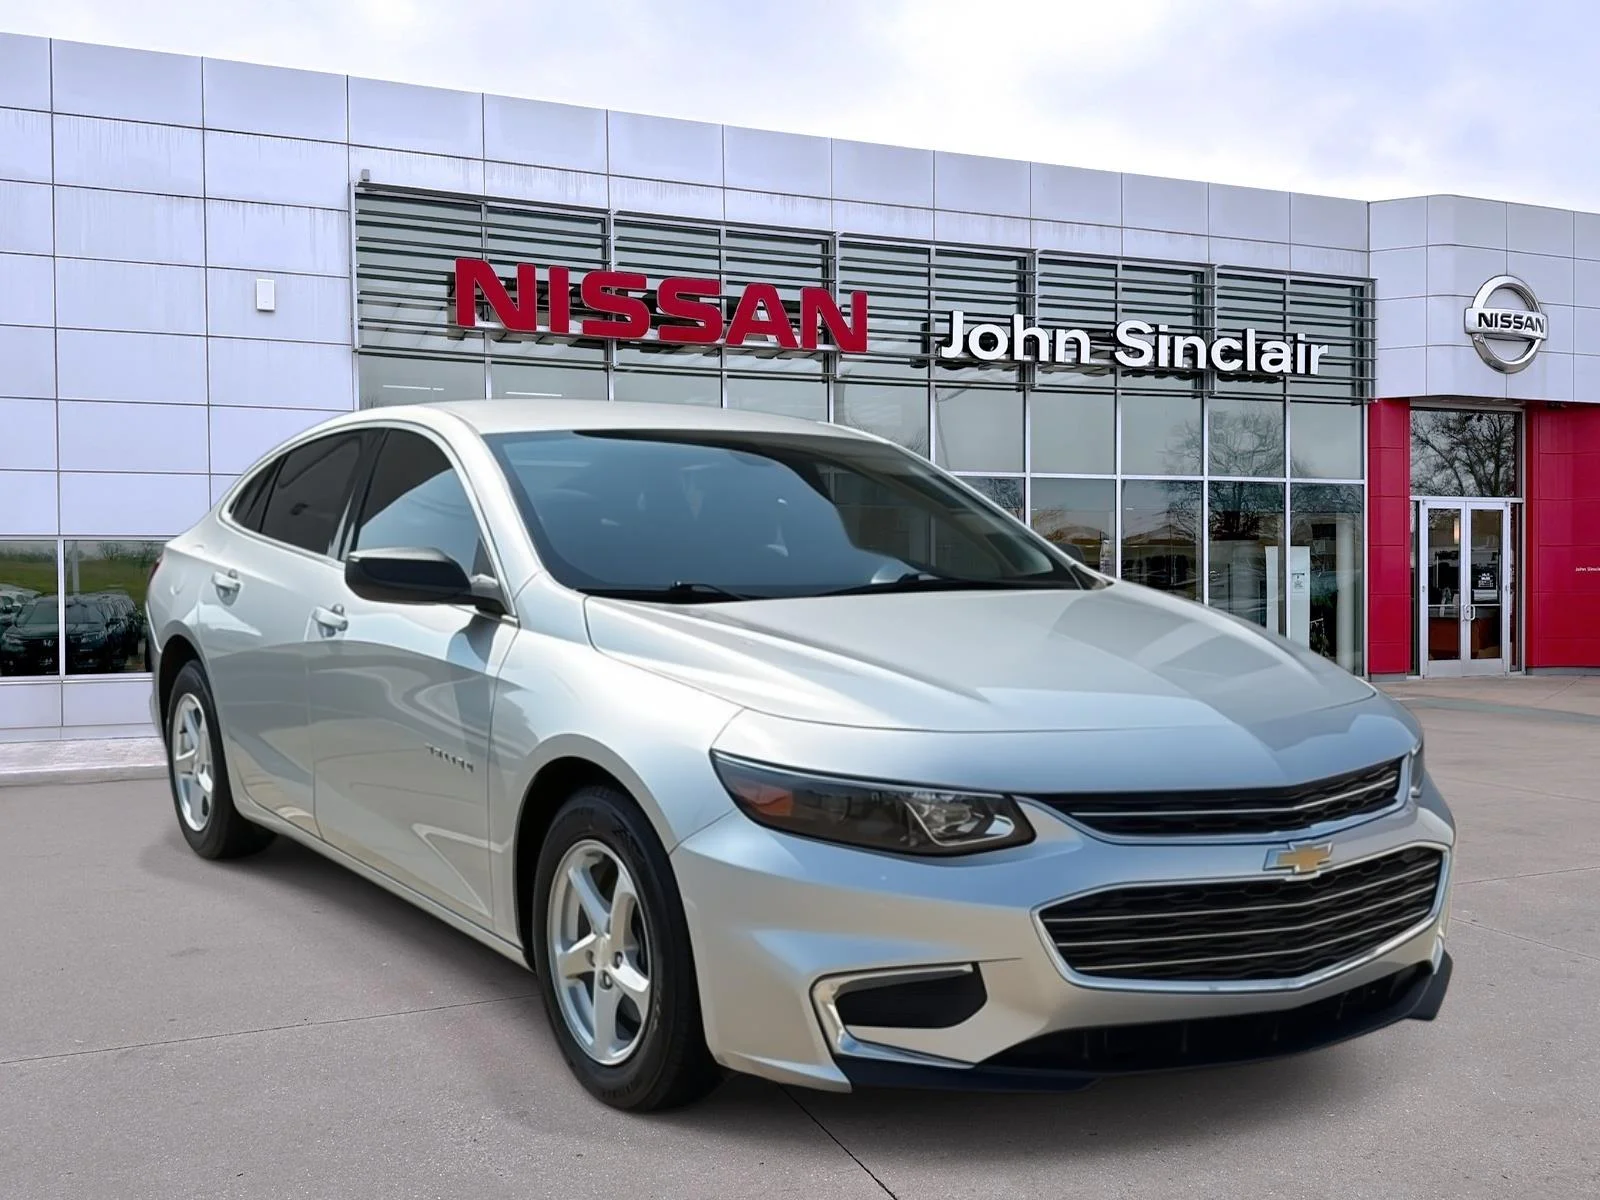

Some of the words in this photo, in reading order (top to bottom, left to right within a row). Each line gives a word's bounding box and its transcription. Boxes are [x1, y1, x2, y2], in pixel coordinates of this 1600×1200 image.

[454, 258, 867, 353] NISSAN
[1478, 312, 1544, 333] NISSAN
[940, 310, 1090, 363] John
[1115, 319, 1329, 375] Sinclair
